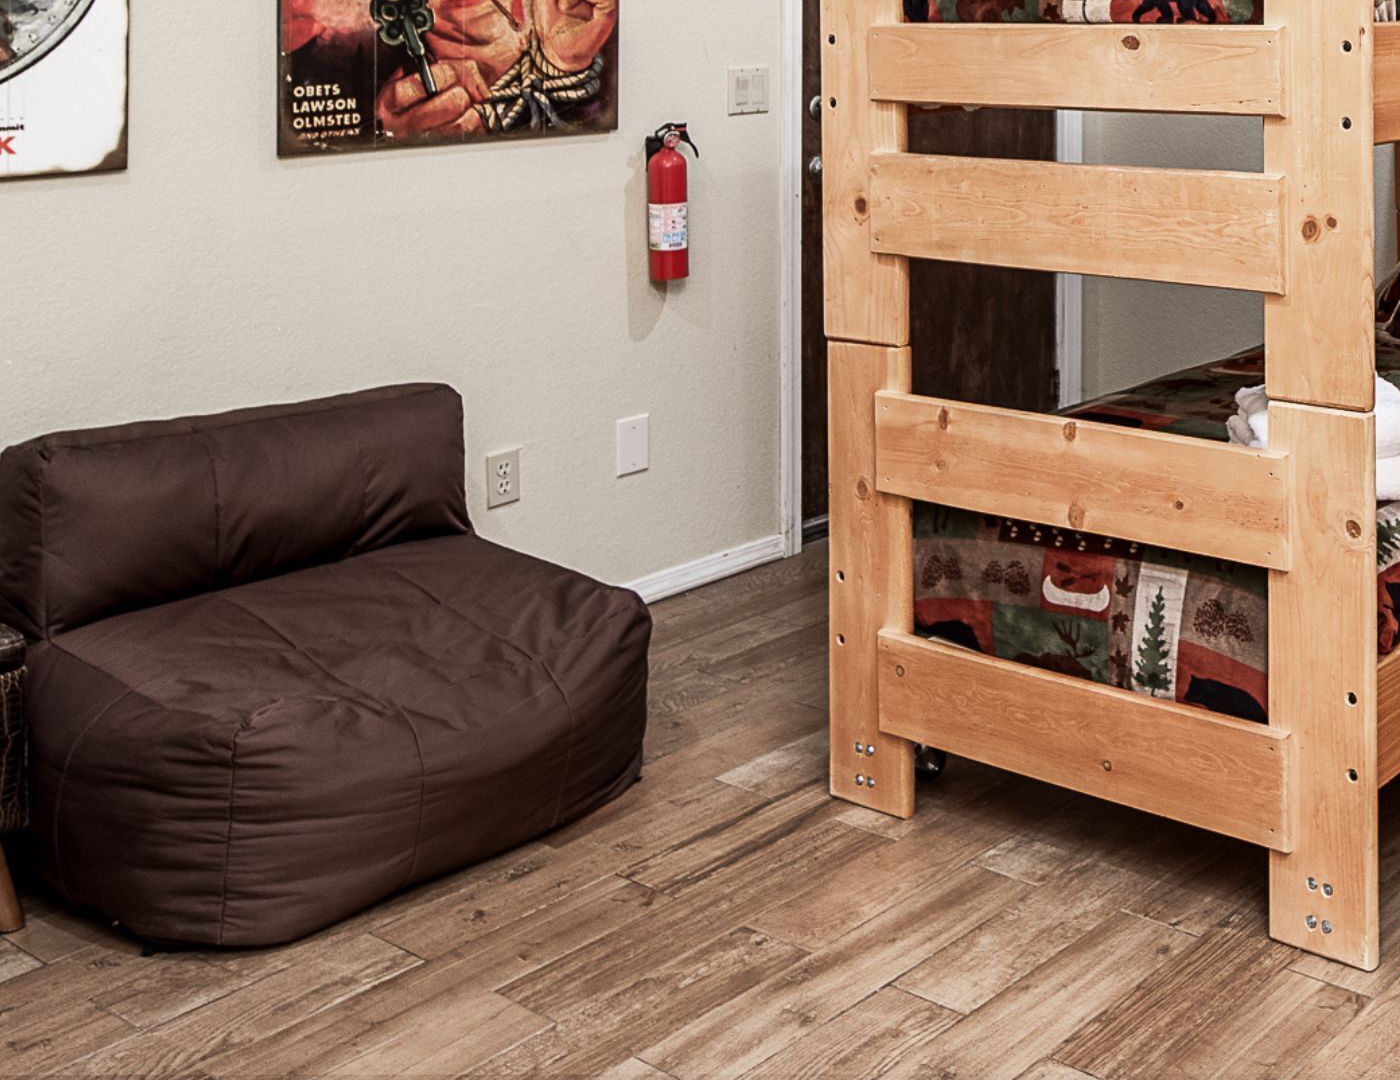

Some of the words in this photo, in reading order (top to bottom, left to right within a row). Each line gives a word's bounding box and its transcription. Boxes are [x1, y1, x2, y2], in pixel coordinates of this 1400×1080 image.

[293, 84, 341, 97] OBETS
[292, 98, 357, 114] LAWSON
[293, 113, 361, 130] OLMSTED
